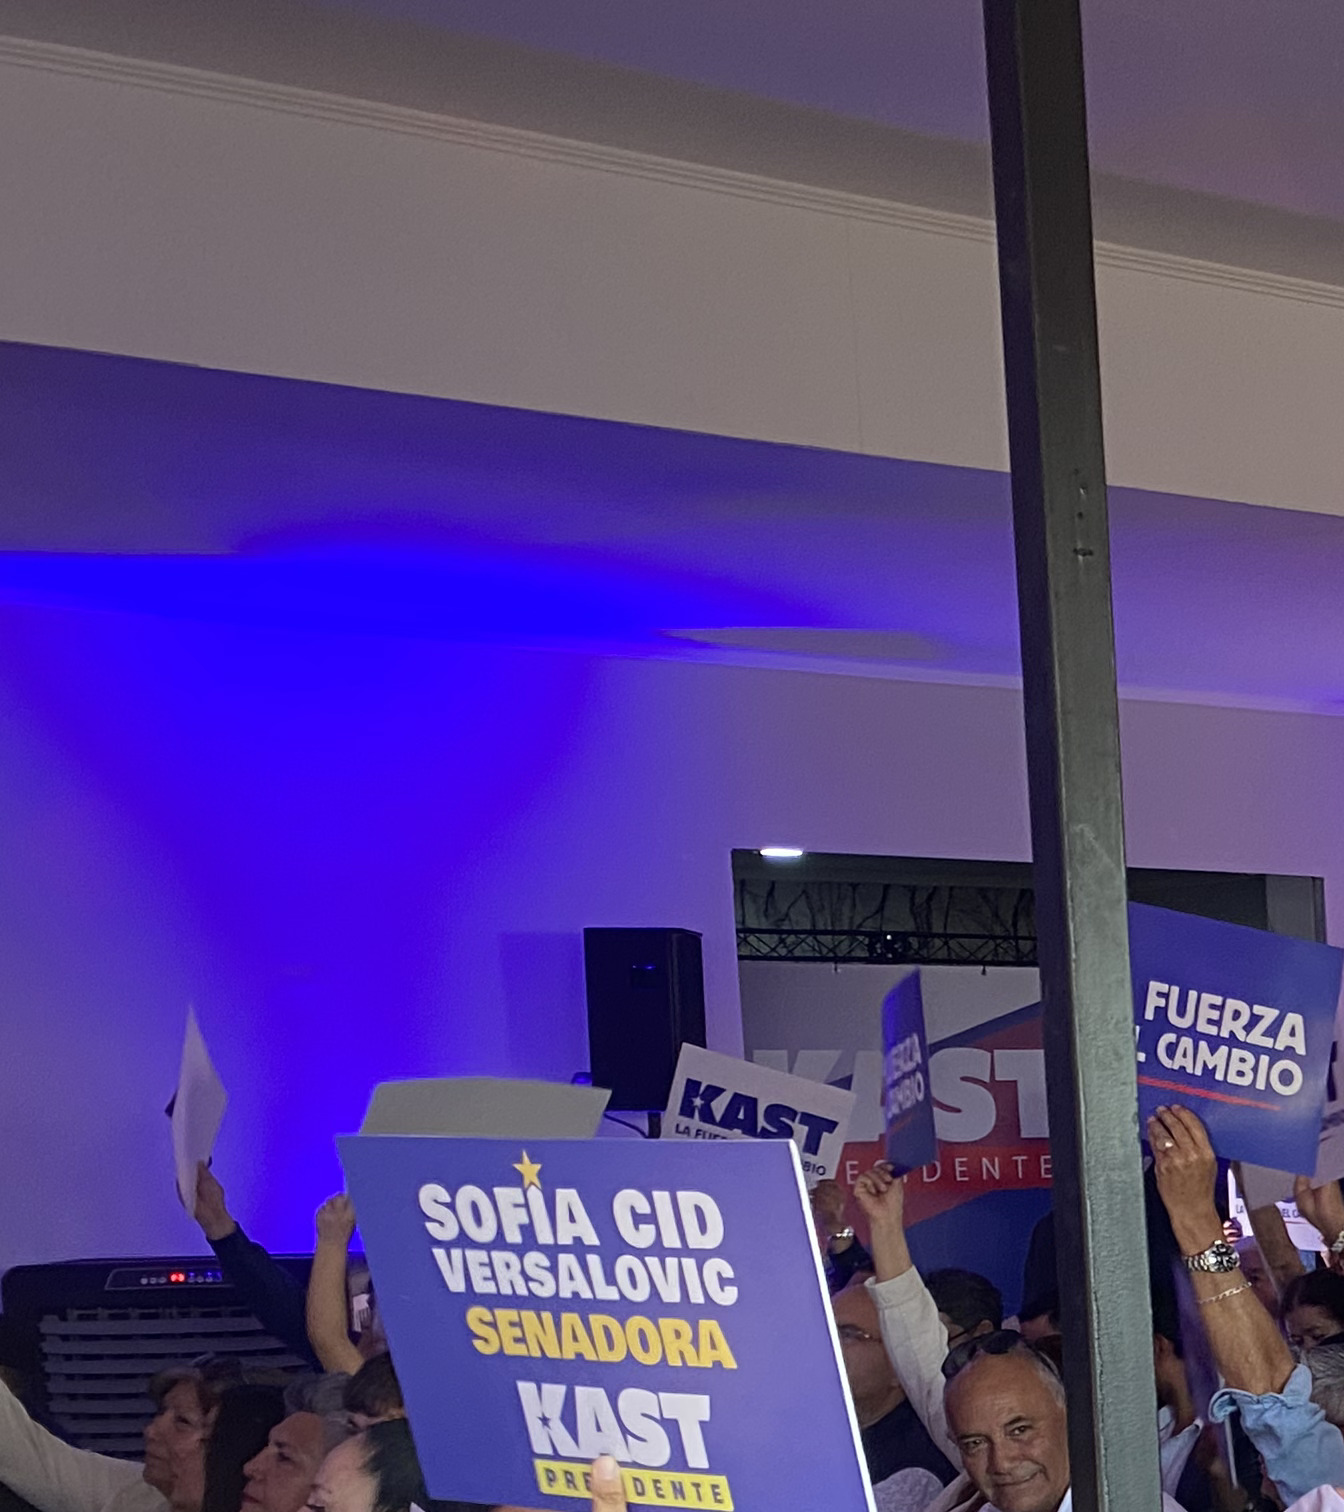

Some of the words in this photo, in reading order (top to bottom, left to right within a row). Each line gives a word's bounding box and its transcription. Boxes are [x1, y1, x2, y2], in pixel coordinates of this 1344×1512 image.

[1144, 980, 1306, 1056] FUERZA
[1157, 1033, 1303, 1096] CAMBIO
[678, 1078, 839, 1156] KAST
[675, 1123, 690, 1138] LA
[802, 1159, 827, 1177] BIO
[846, 1156, 1052, 1184] EDENTE
[612, 1189, 724, 1249] CID
[431, 1247, 739, 1306] VERSALOVIC
[466, 1307, 738, 1370] SENADORA
[516, 1380, 710, 1469] KAST
[543, 1468, 725, 1504] PREDENTE
